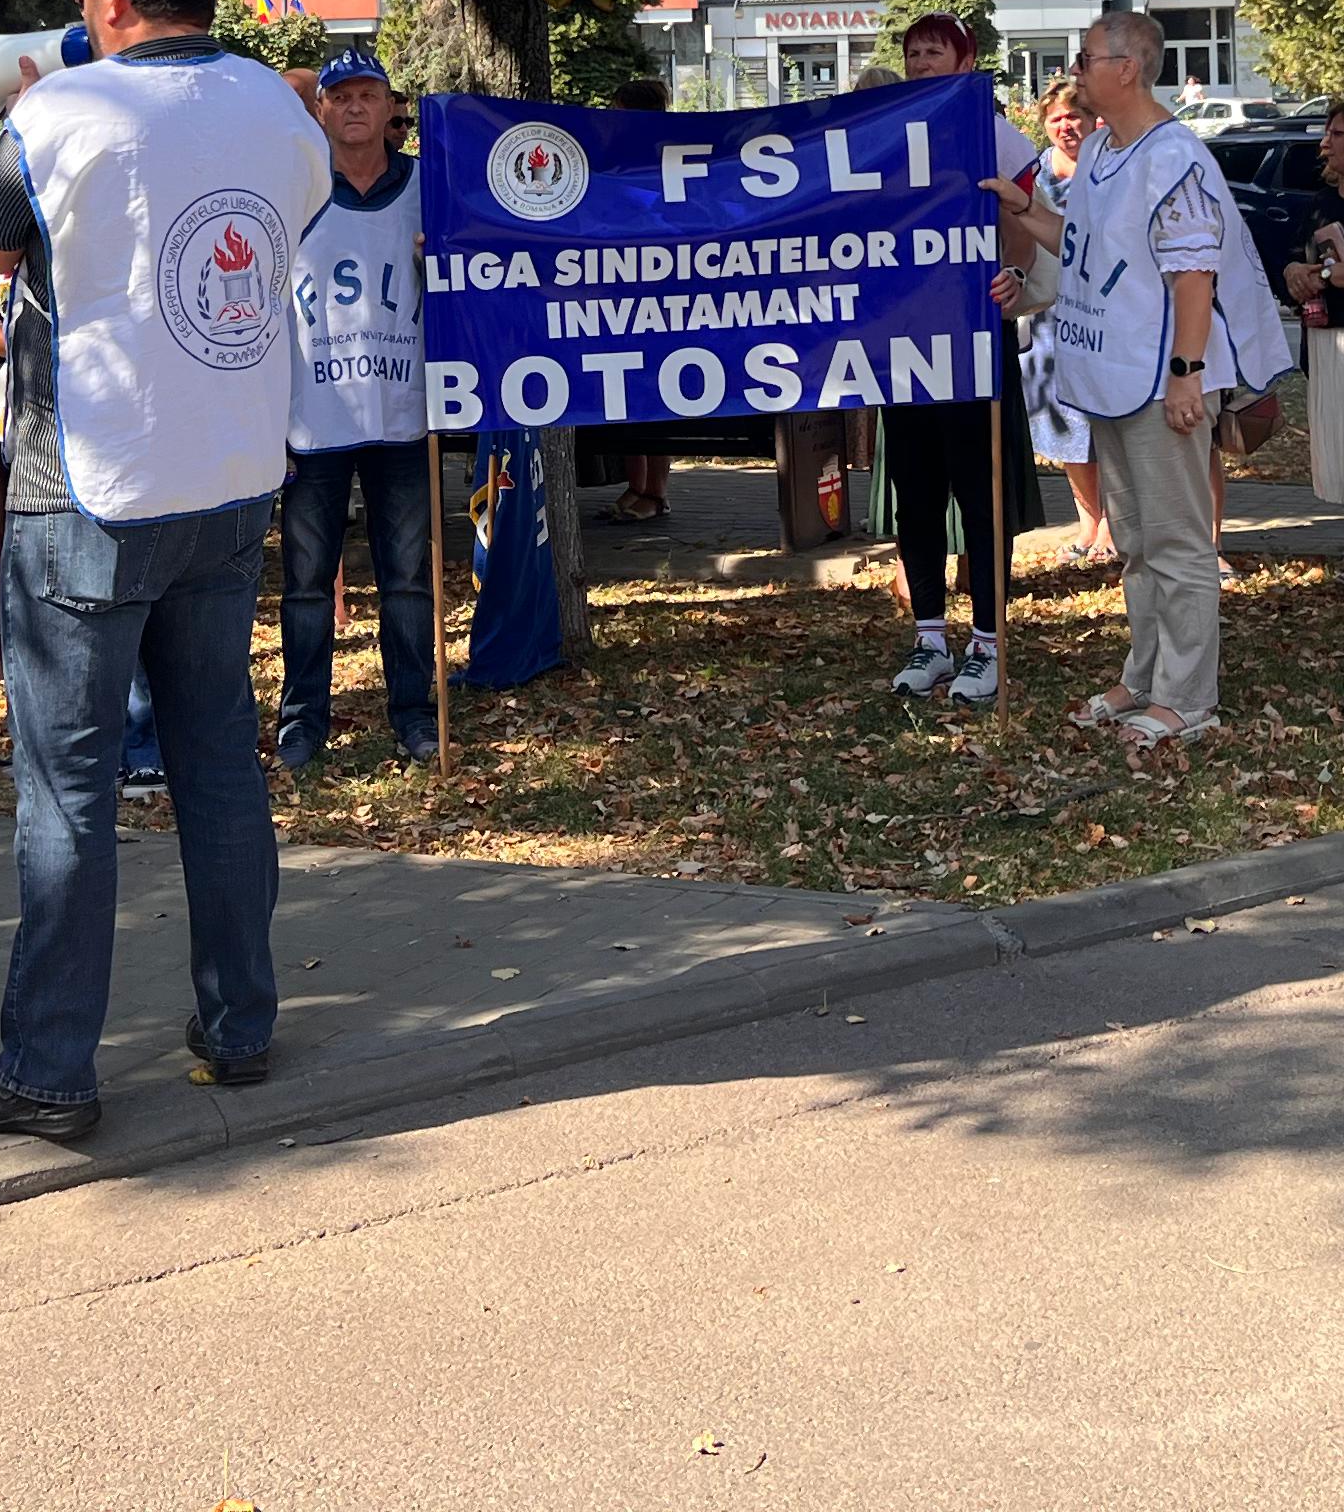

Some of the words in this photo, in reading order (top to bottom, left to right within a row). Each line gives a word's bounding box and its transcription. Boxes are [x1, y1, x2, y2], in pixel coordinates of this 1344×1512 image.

[330, 50, 375, 72] FSLI
[661, 121, 931, 203] FSLI
[166, 198, 229, 265] SINDICATELOR
[425, 251, 541, 292] LIGA
[554, 232, 900, 286] SINDICATELOR
[912, 225, 997, 264] DIN
[1062, 222, 1128, 298] SLI
[217, 302, 259, 322] FSLI
[312, 332, 358, 347] SINDICAT
[547, 284, 860, 339] INVATAMANT
[1055, 317, 1103, 353] TOSANI
[425, 331, 993, 431] BOTOSANI
